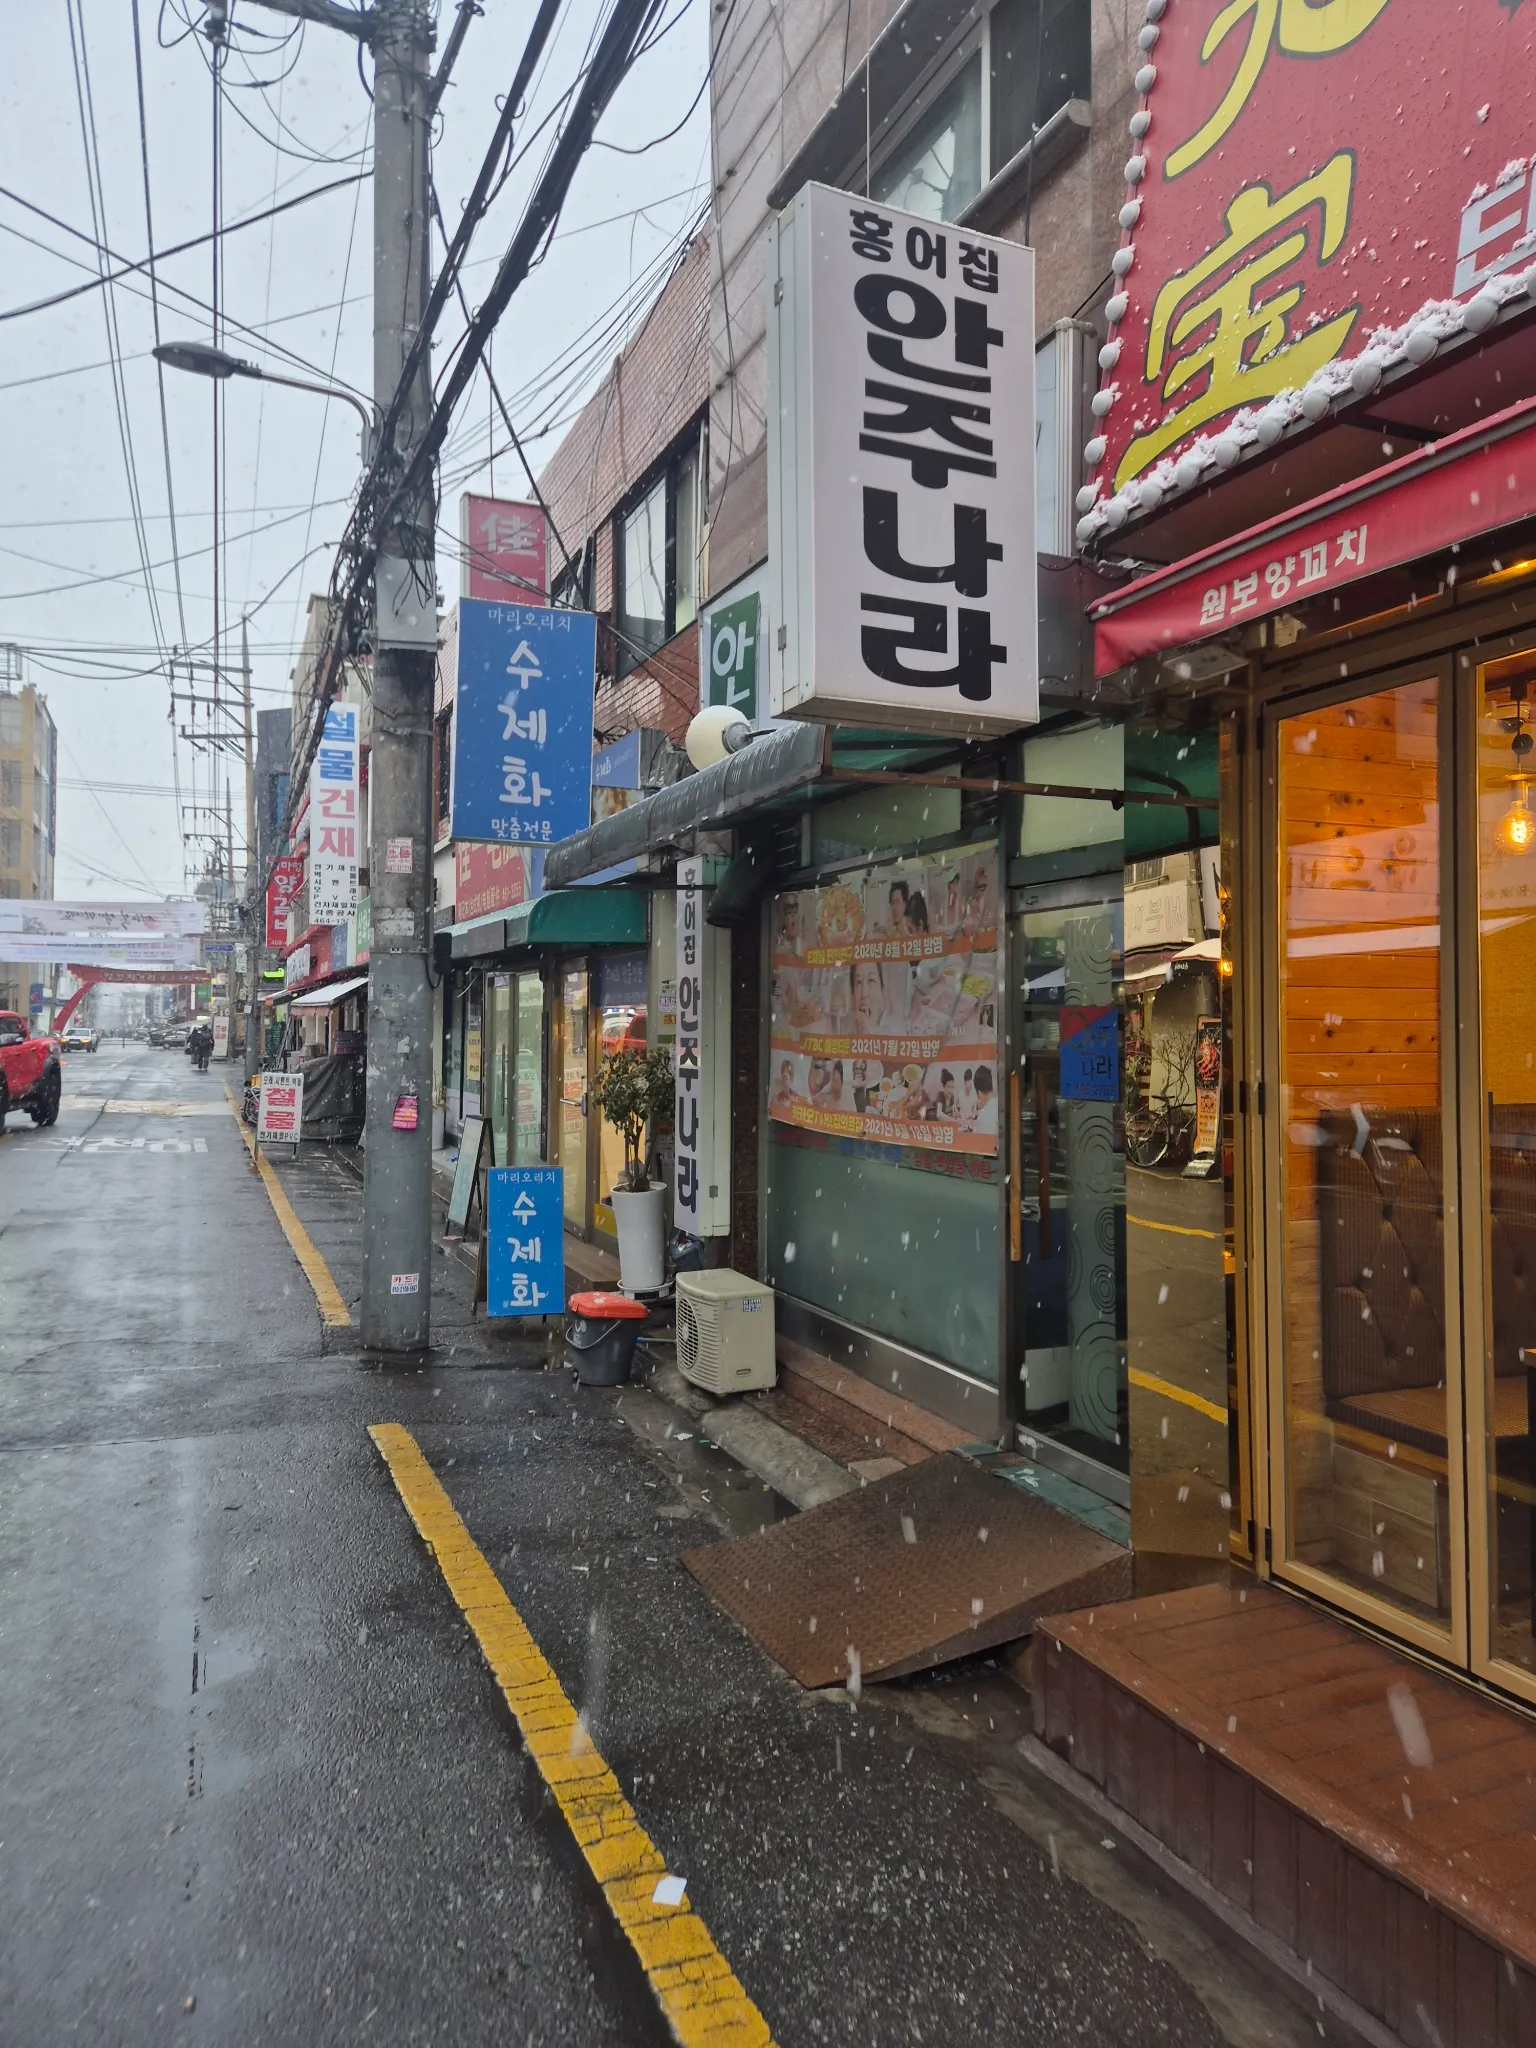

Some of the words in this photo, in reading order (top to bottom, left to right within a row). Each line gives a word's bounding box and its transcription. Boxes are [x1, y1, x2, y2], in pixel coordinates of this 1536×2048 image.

[849, 207, 999, 295] 홍어집
[853, 272, 1008, 702] 안주나라
[1199, 524, 1368, 627] 원보양꼬치
[487, 608, 571, 633] 마리오리치
[498, 640, 552, 807] 수제화
[491, 817, 553, 841] 맞춤전문
[683, 867, 696, 966] 홍어집
[854, 942, 883, 959] 2020년
[885, 941, 900, 957] 8월
[902, 939, 922, 956] 12일
[924, 935, 943, 954] 방영
[852, 1038, 881, 1056] 2021년
[882, 1039, 898, 1057] 7월
[900, 1040, 920, 1057] 27일
[921, 1040, 941, 1059] 방영
[678, 975, 699, 1214] 안주나라
[864, 1117, 894, 1137] 2021년
[910, 1125, 932, 1144] 18일
[932, 1126, 954, 1145] 방영
[497, 1172, 556, 1184] 마리오리치
[506, 1190, 548, 1308] 수제화
